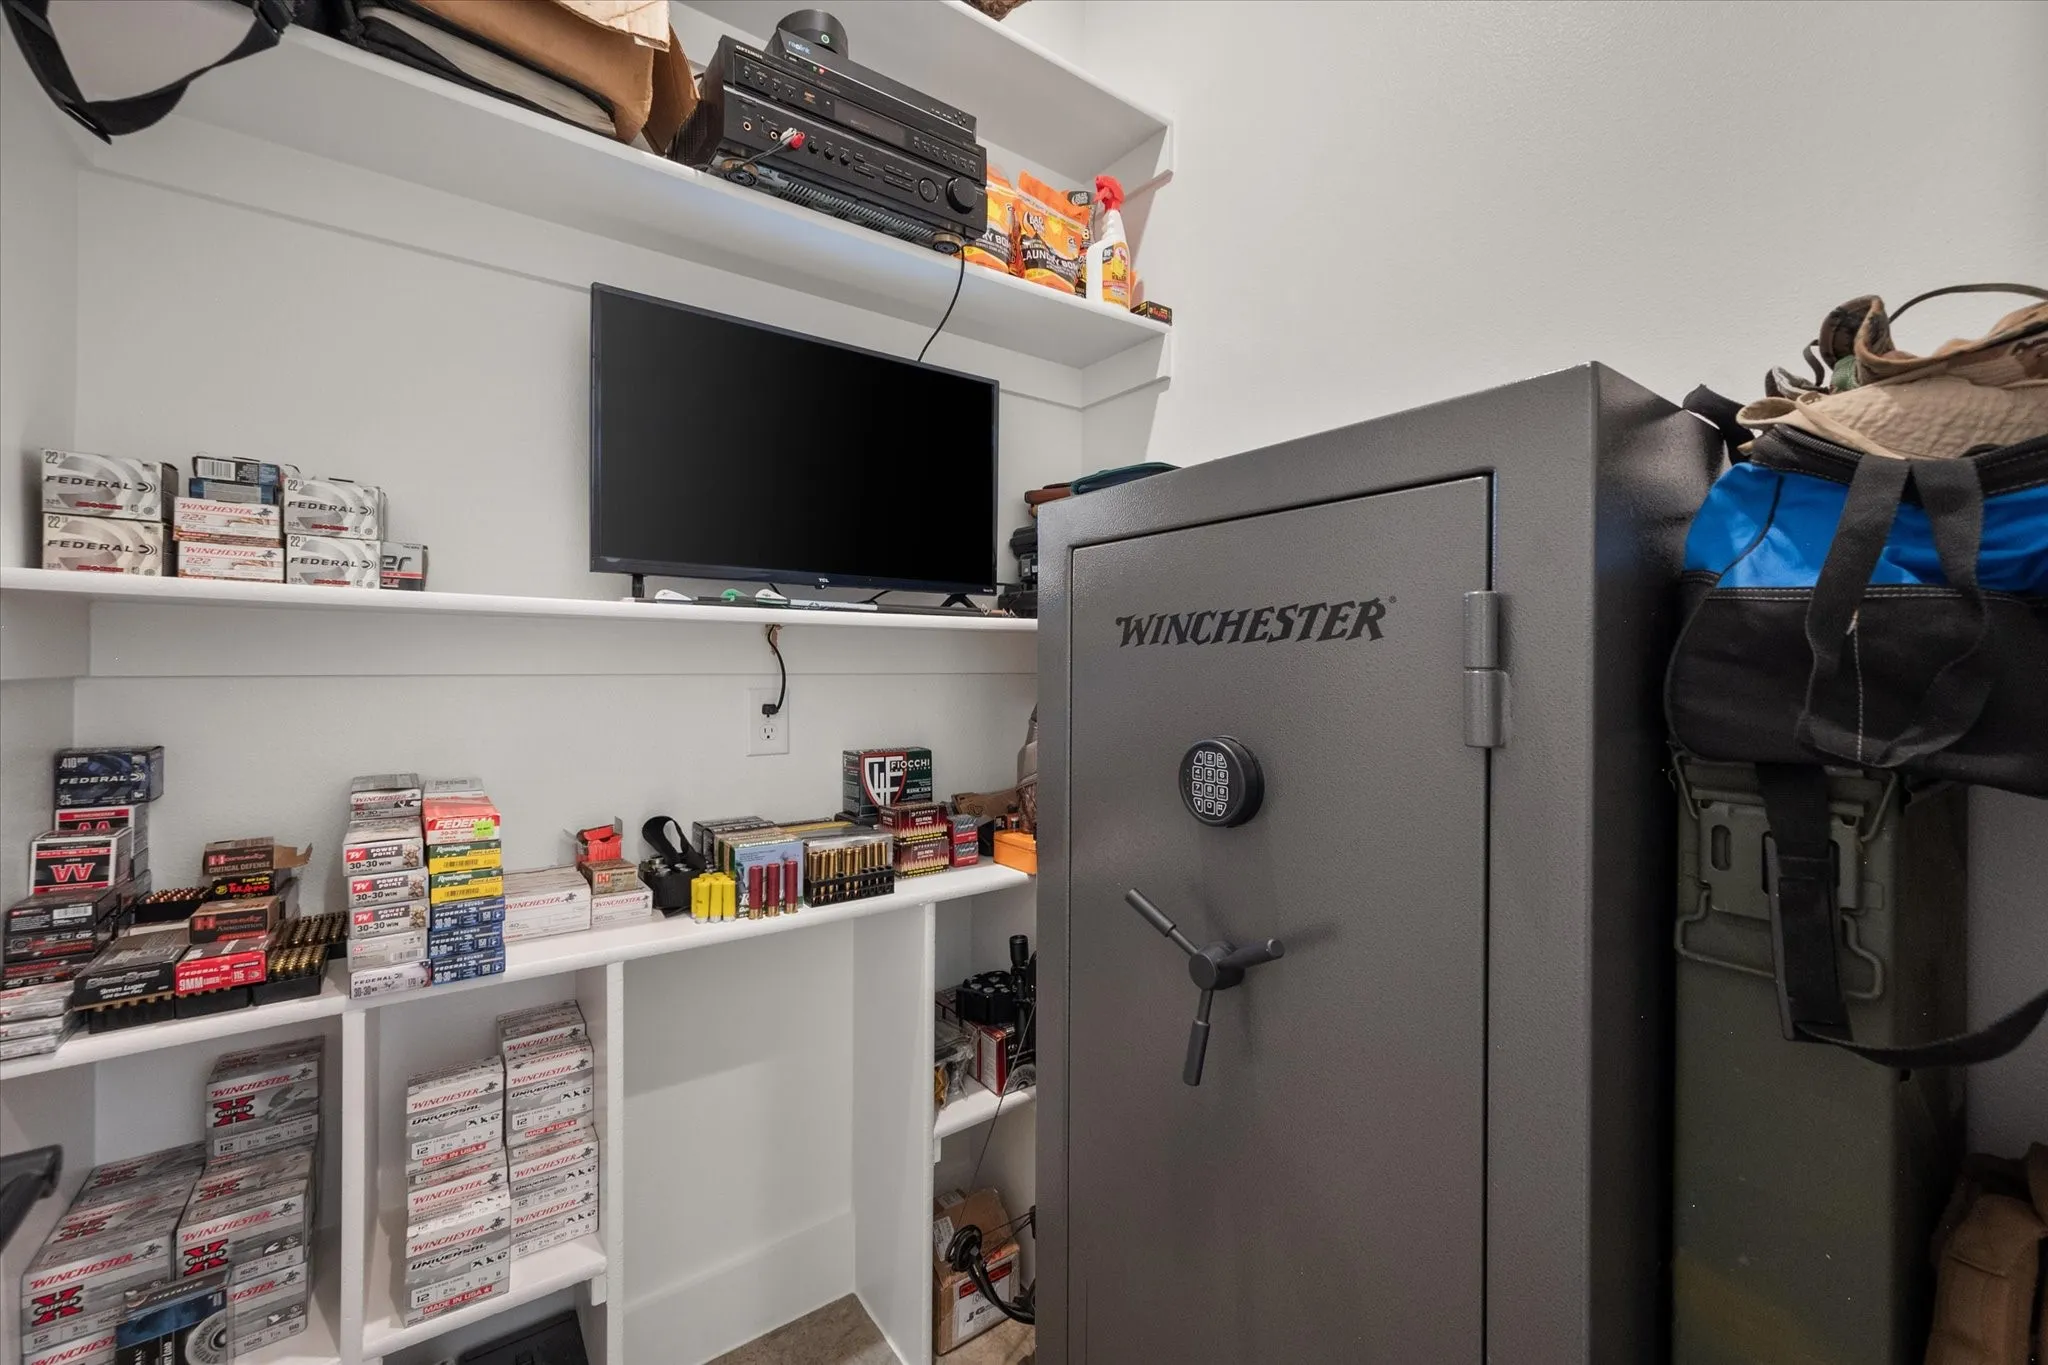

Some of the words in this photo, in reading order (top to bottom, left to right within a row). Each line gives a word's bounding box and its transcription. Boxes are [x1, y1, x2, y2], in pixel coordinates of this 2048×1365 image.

[45, 451, 58, 464] 22
[45, 475, 132, 490] FEDERAL
[287, 480, 298, 491] 22
[180, 502, 253, 515] WINCHESTER
[287, 501, 356, 513] FEDERAL
[48, 516, 60, 528] 22
[47, 540, 134, 553] FEDERAL
[290, 536, 301, 547] 22
[184, 546, 257, 557] WINCHESTER
[290, 557, 358, 568] FEDERAL
[1115, 597, 1386, 648] WINCHESTER
[891, 758, 931, 770] FIOCCHI
[60, 774, 127, 785] FEDERAL
[435, 817, 493, 830] FEDER
[373, 850, 396, 858] POINT
[209, 864, 240, 874] CRITICAL
[240, 861, 271, 871] DEFENSE
[349, 860, 378, 870] 30-30
[376, 876, 404, 885] POWER
[355, 891, 384, 901] 30-30
[594, 896, 641, 907] WINCHESTER
[504, 896, 561, 910] WINCHESTER
[435, 909, 467, 918] FEDERAL
[357, 922, 385, 933] 30-30
[431, 937, 463, 945] FEDERAL
[179, 967, 219, 977] FEDERAL
[435, 962, 466, 972] FEDERAL
[179, 977, 203, 991] 9MM
[354, 976, 392, 985] FEDERAL
[507, 1033, 565, 1052] WINCHESTER
[511, 1065, 572, 1085] WINCHESTER
[211, 1074, 291, 1097] WINCHESTER
[511, 1081, 567, 1098] UNIVERSAL
[411, 1088, 479, 1110] WINCHESTER
[411, 1105, 479, 1126] UNIVERSAL
[516, 1118, 527, 1126] 12
[526, 1128, 545, 1138] MADE
[416, 1146, 429, 1156] 12
[422, 1152, 448, 1166] MADE
[449, 1151, 459, 1159] IN
[460, 1146, 477, 1155] USA
[514, 1154, 577, 1178] WINCHESTER
[413, 1180, 482, 1205] WINCHESTER
[514, 1199, 577, 1225] WINCHESTER
[182, 1210, 271, 1241] WINCHESTER
[411, 1224, 485, 1253] WINCHESTER
[411, 1243, 485, 1271] UNIVERSAL
[30, 1253, 133, 1290] WINCHESTER
[416, 1293, 430, 1304] 12
[424, 1301, 451, 1314] MADE
[452, 1296, 462, 1304] IN
[464, 1289, 482, 1299] USA
[31, 1335, 116, 1365] WINCHEST
